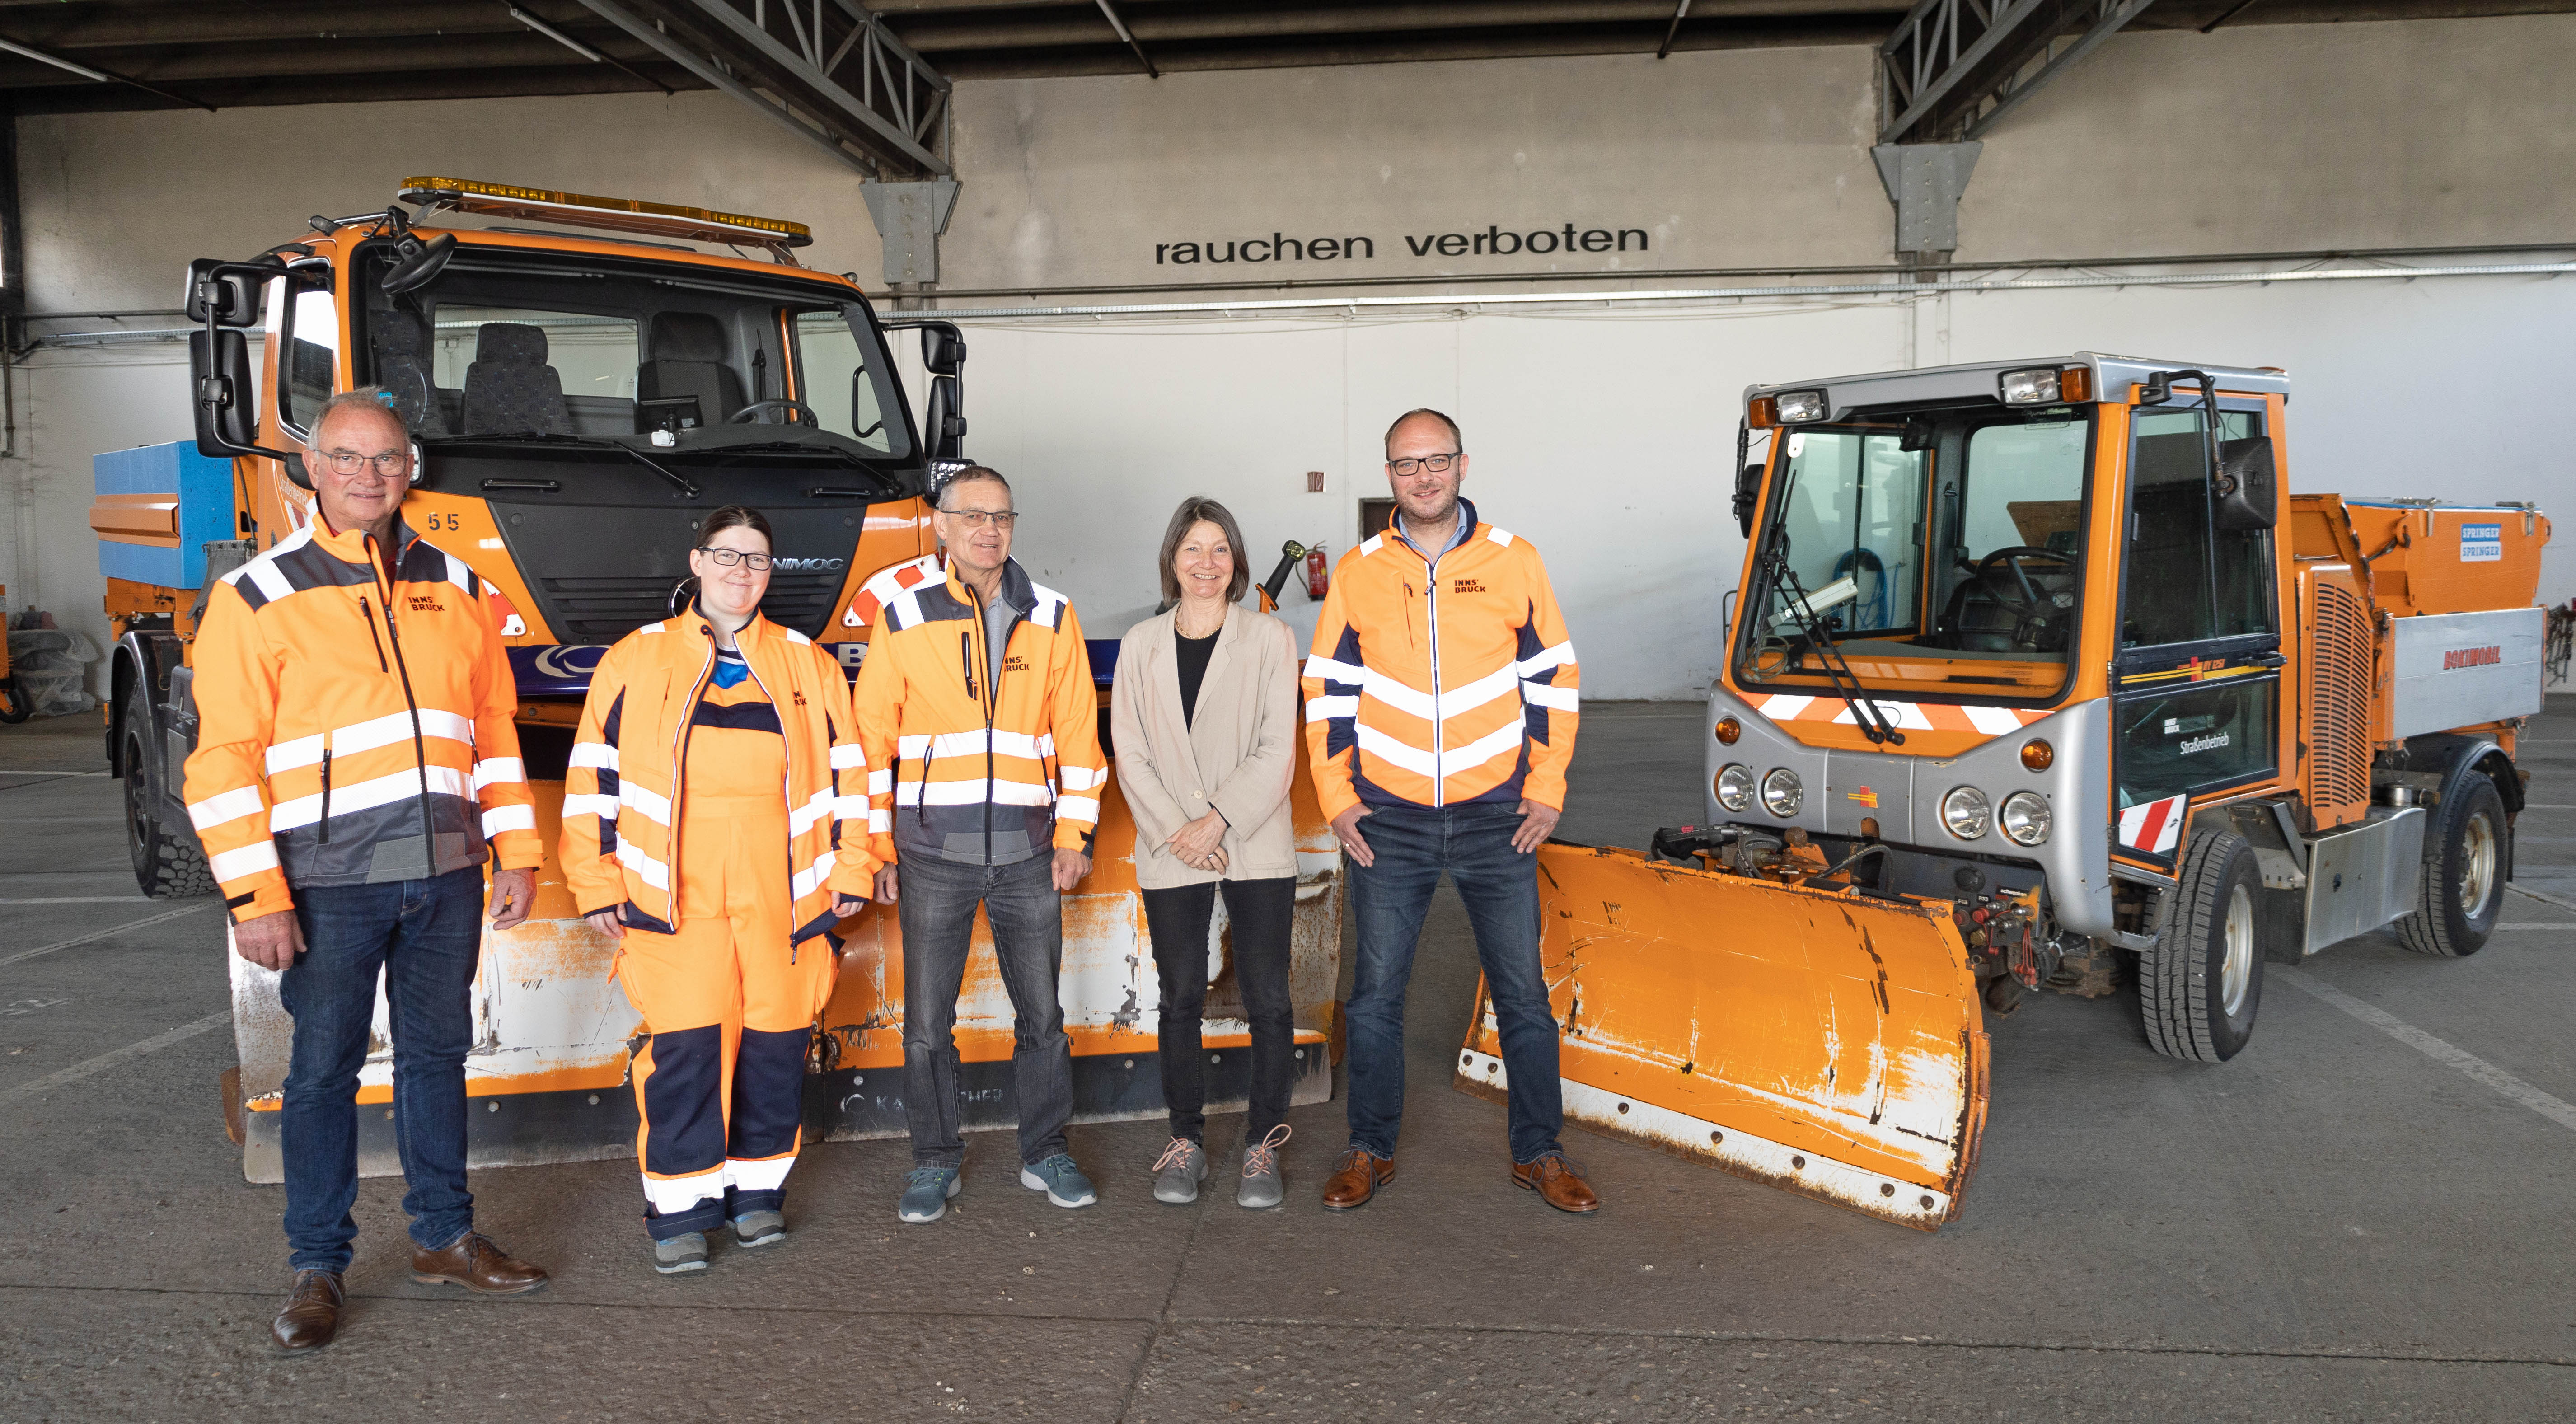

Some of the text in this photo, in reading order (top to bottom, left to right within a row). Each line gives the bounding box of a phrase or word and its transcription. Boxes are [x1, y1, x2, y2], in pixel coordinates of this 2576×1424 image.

[1156, 223, 1648, 265] rauchen verboten
[2462, 528, 2499, 538] SPRINGER
[2463, 546, 2499, 556] SPRINGER
[773, 558, 843, 570] NIMOG
[412, 604, 445, 612] BRUCK
[2443, 646, 2501, 670] BOKIMOBIL
[1004, 664, 1030, 672] RUCK
[2180, 731, 2229, 755] Straßenbetrieb
